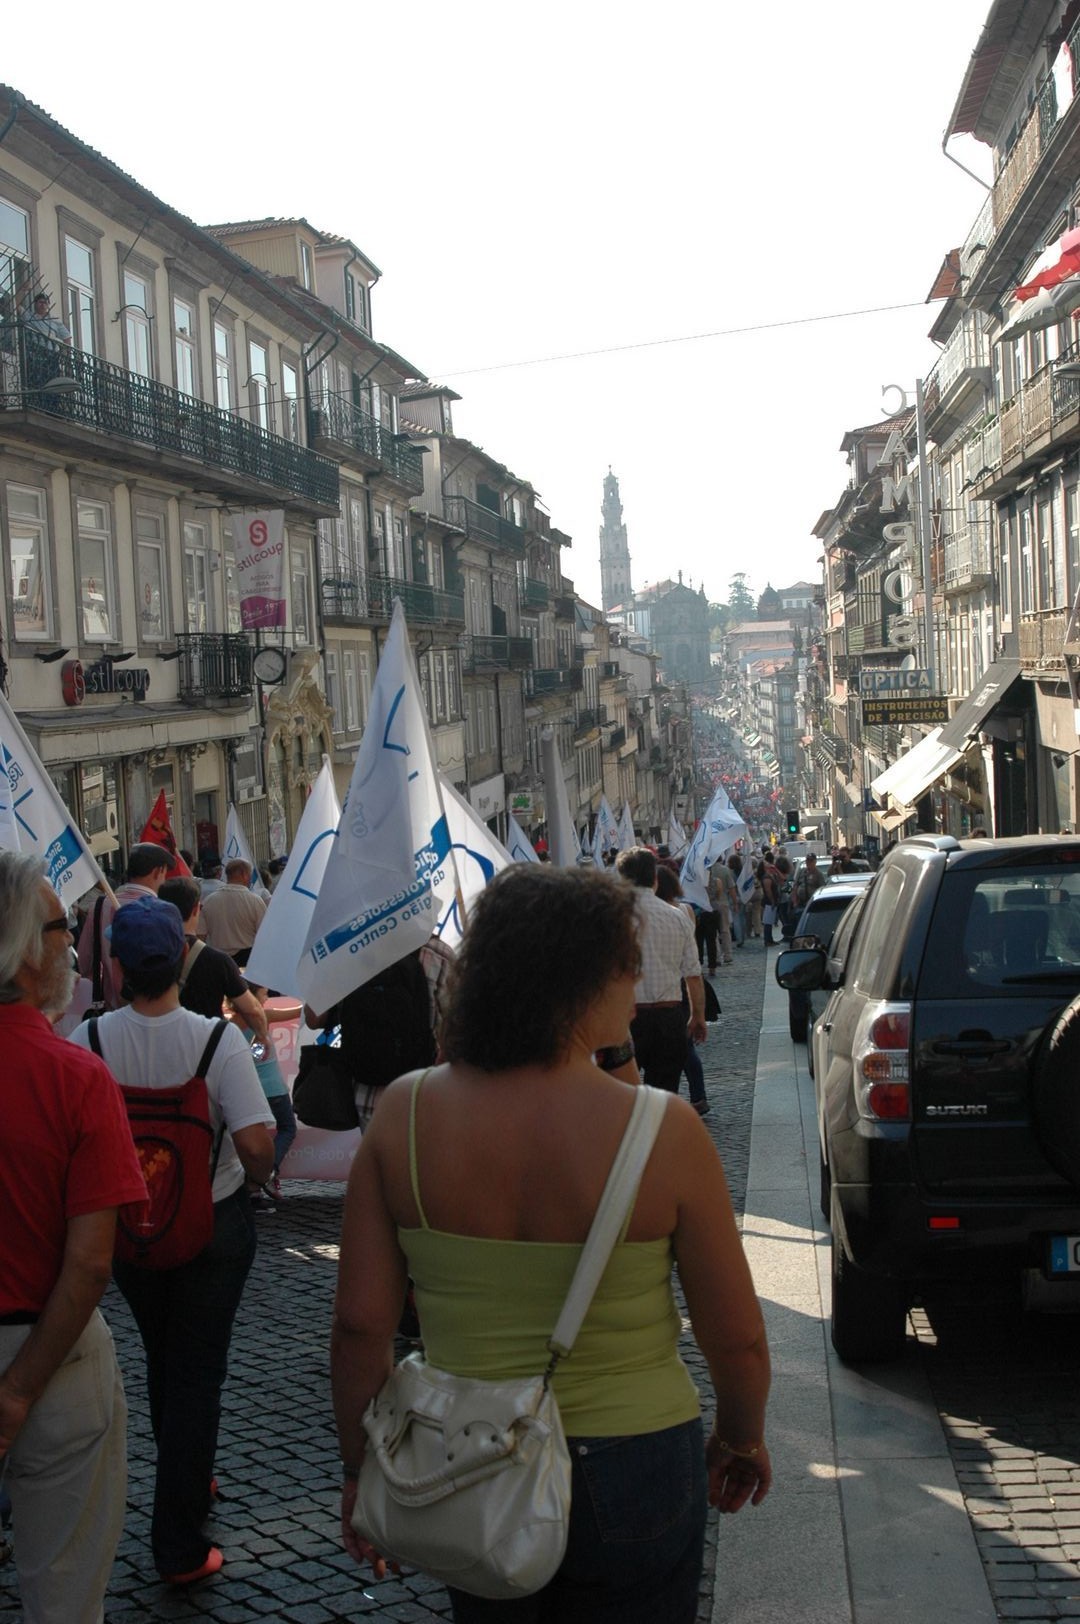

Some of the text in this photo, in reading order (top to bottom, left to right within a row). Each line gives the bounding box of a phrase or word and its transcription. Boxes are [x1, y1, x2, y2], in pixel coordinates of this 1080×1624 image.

[236, 541, 284, 573] stilcoup
[864, 699, 948, 711] INSTRUMENTOS
[868, 709, 945, 722] DE PRECISÃO
[926, 1104, 987, 1116] SUZUKI
